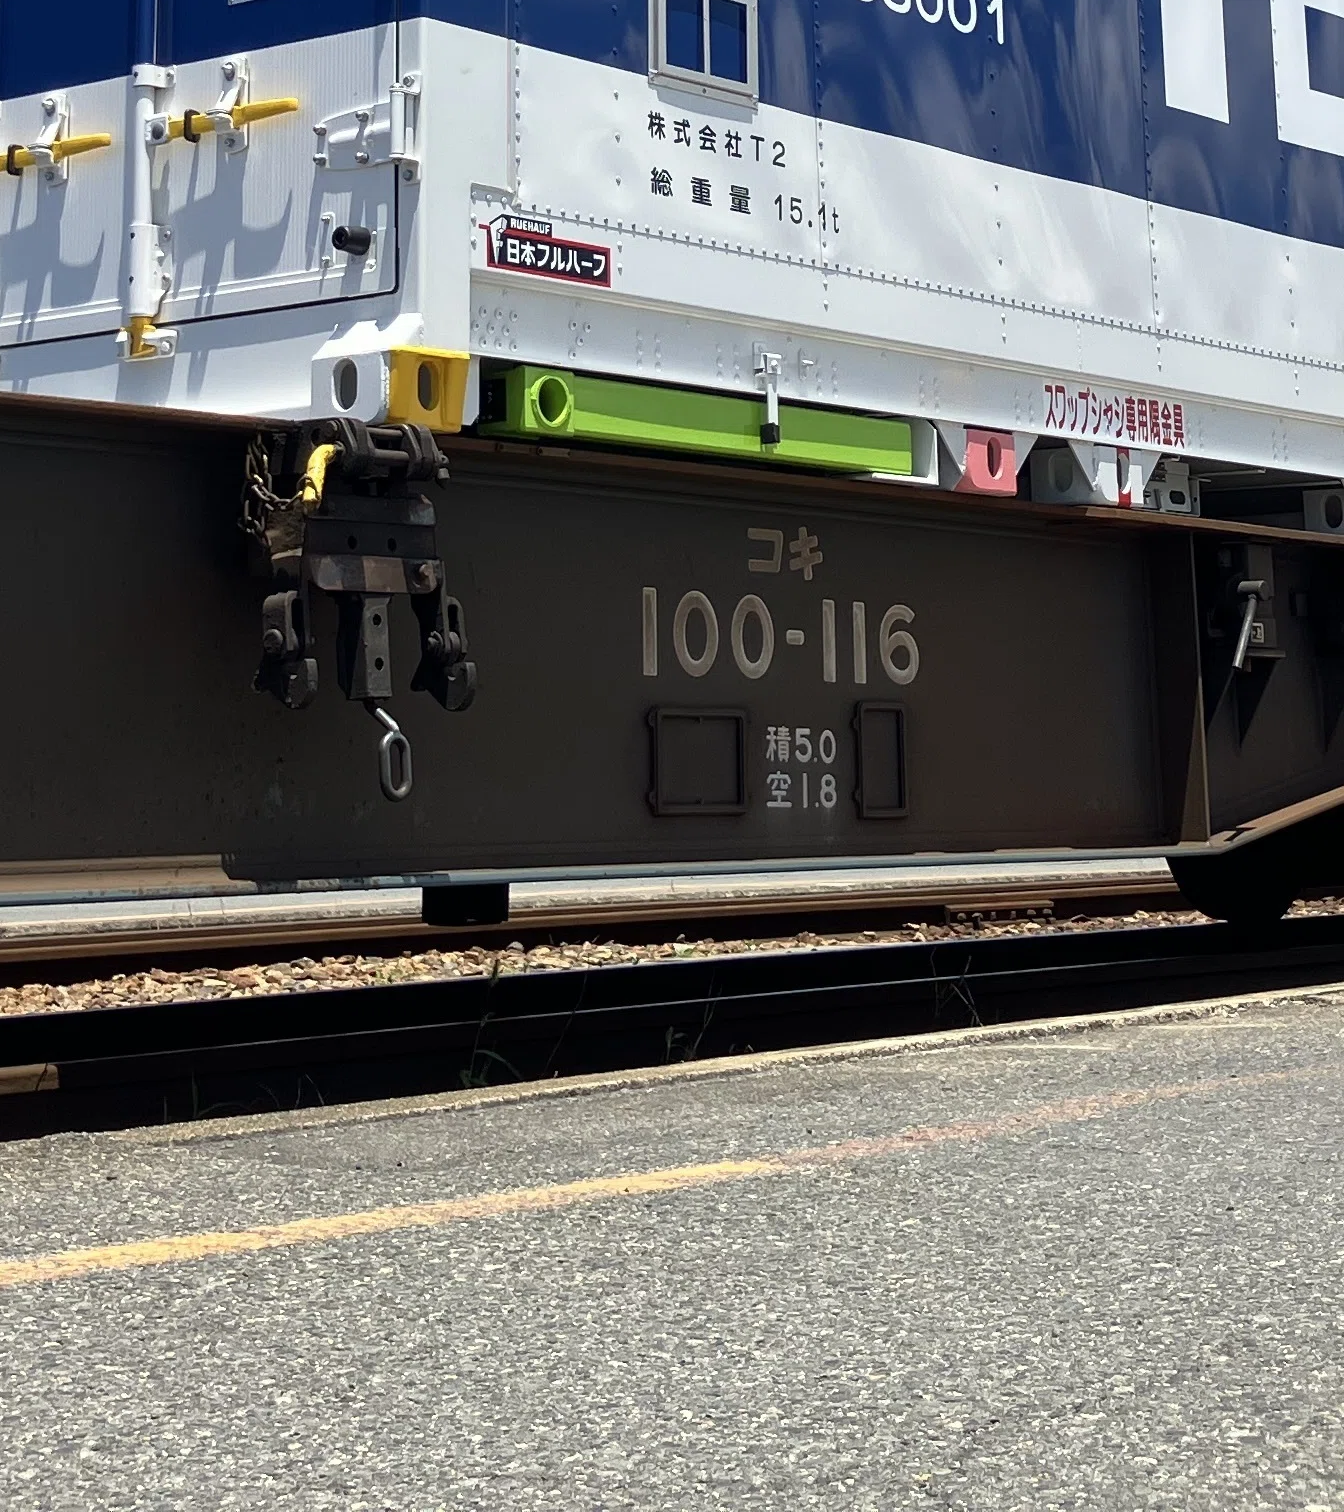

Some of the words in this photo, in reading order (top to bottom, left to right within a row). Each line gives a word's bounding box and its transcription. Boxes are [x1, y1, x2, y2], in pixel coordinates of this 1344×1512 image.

[647, 110, 786, 168] 株式会社T2
[650, 167, 752, 215] 総重量
[774, 193, 841, 233] 15.1t
[506, 237, 607, 277] 日本フルハーフ
[747, 526, 823, 581] コキ
[642, 586, 920, 686] 100-116
